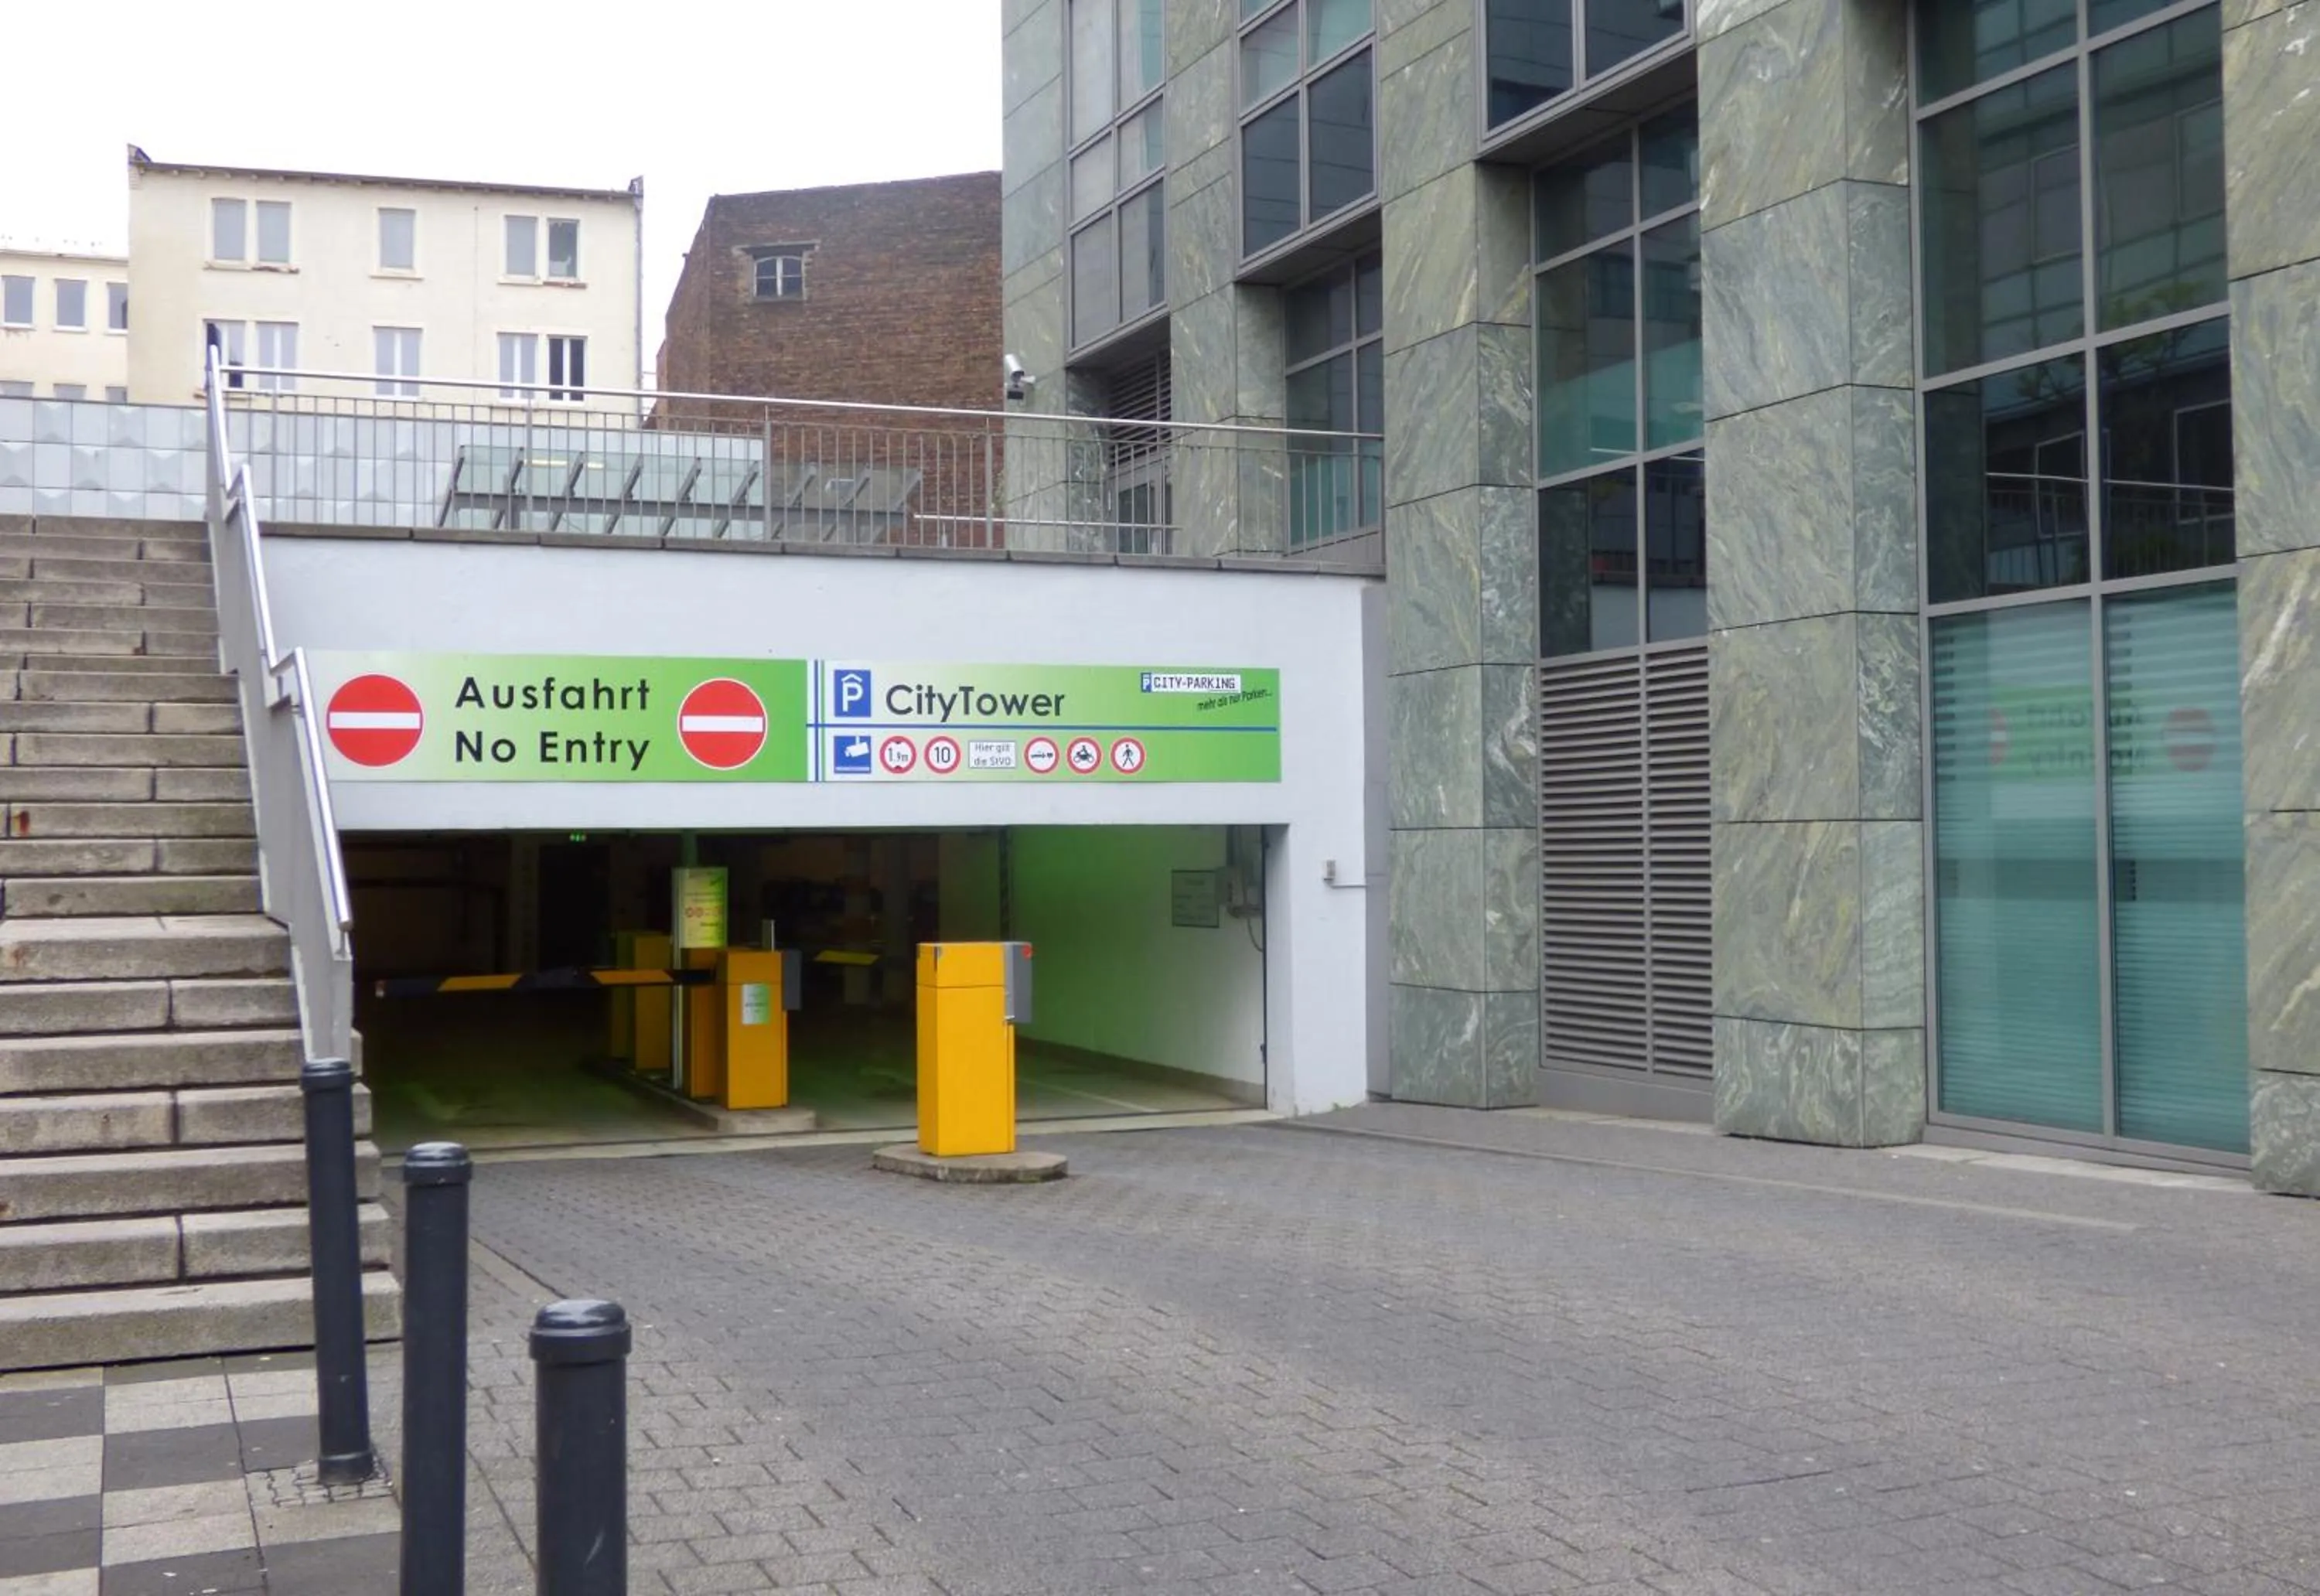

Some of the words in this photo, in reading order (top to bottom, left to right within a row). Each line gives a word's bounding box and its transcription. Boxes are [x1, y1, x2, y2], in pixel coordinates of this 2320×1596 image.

[455, 676, 650, 711] Ausfahrt
[1153, 676, 1236, 690] CITY-PARKING
[842, 680, 863, 712] P
[885, 684, 1066, 722] CityTower
[455, 731, 516, 763] No
[539, 731, 650, 770] Entry
[933, 746, 951, 763] 10
[974, 743, 993, 752] Hier
[974, 756, 988, 766] die
